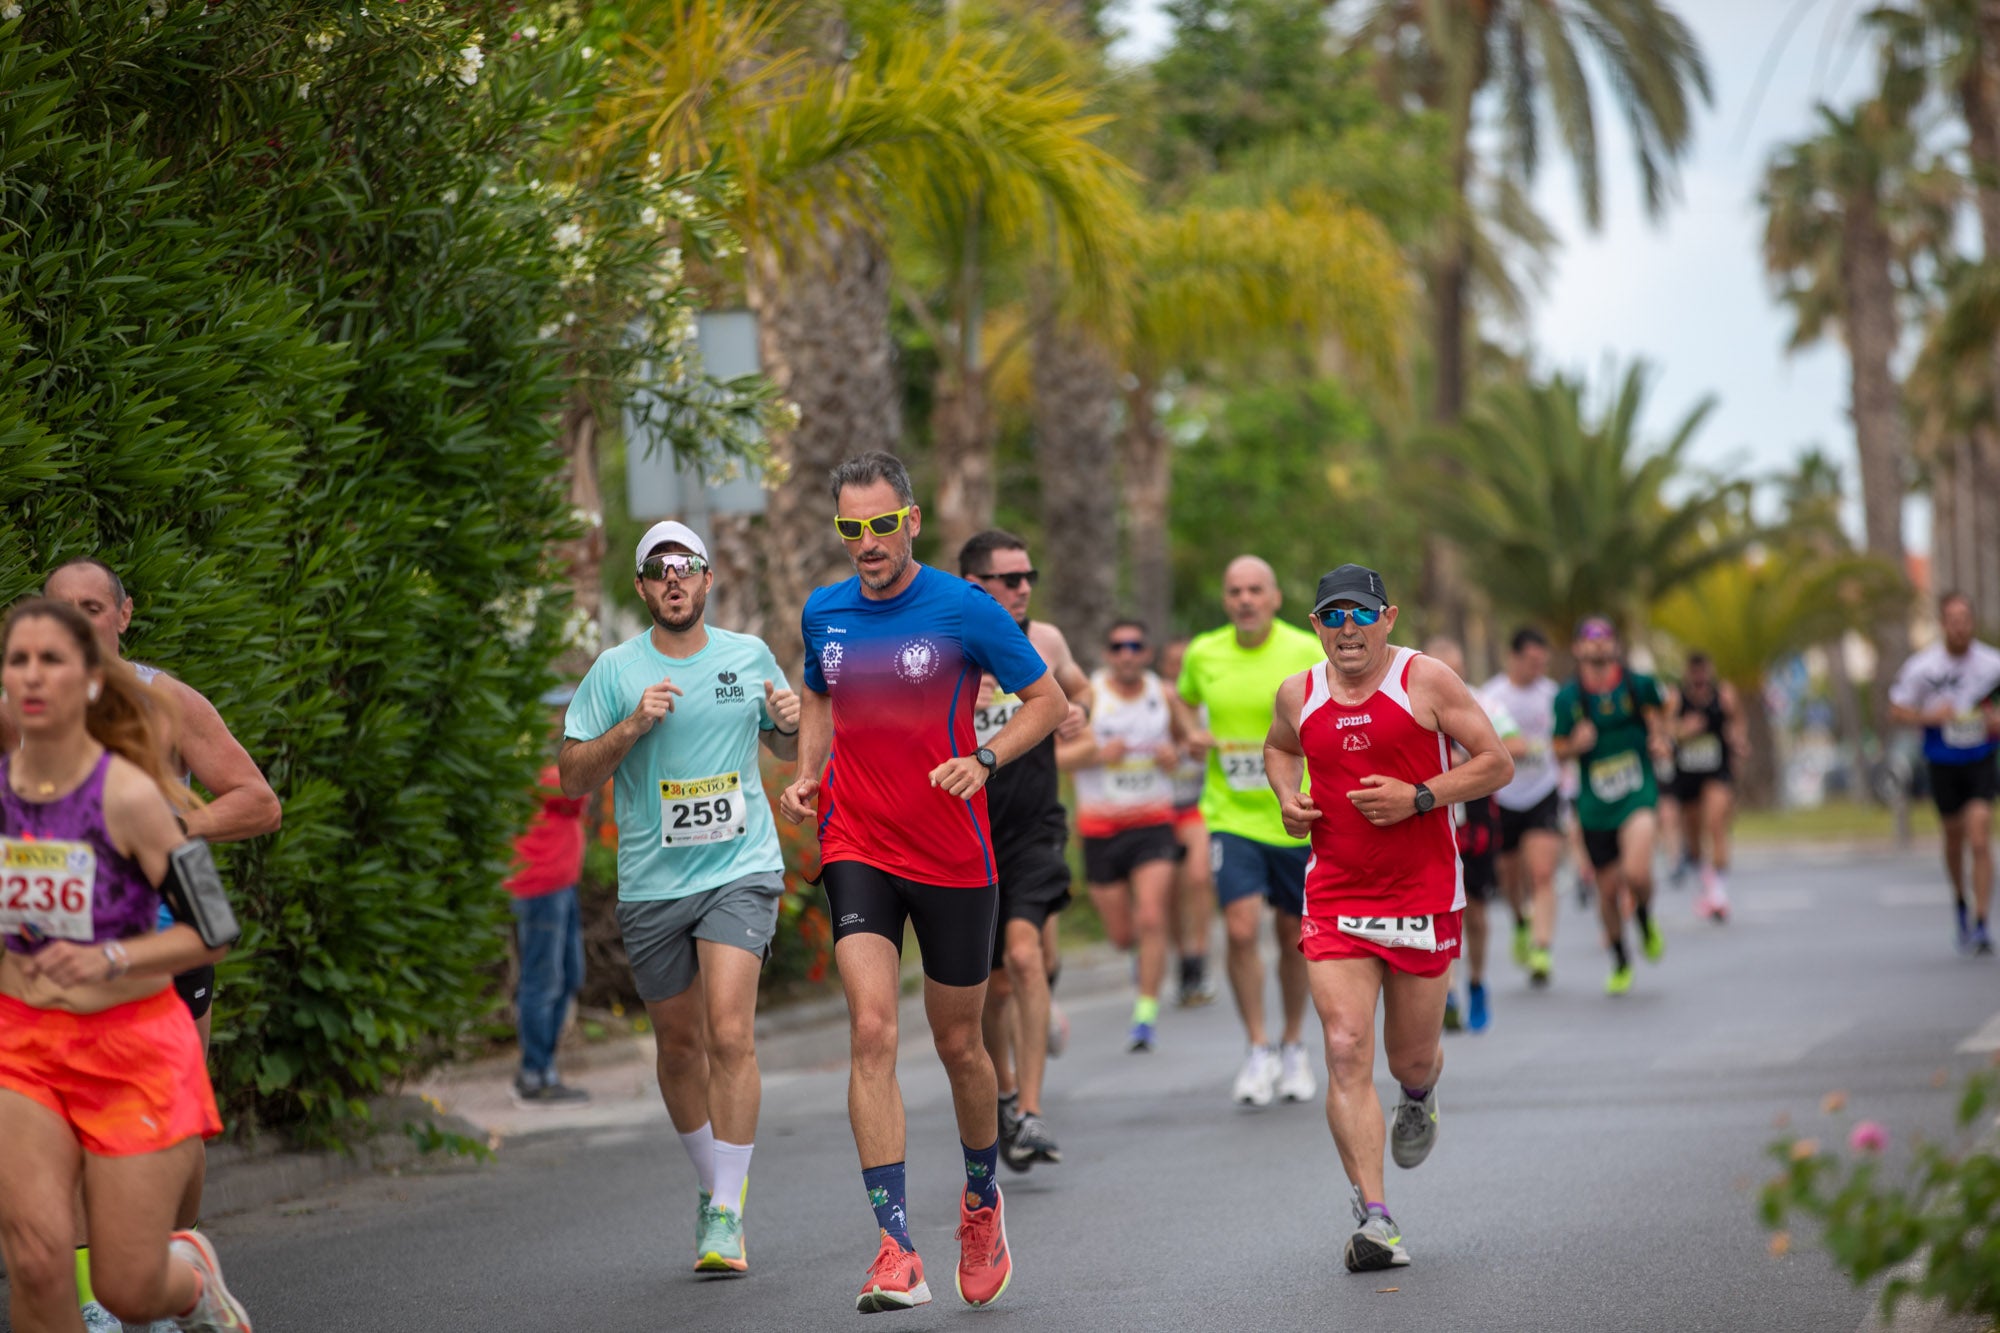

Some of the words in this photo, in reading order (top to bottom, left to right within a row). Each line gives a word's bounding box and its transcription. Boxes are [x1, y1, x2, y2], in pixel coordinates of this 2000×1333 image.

[715, 686, 744, 699] RUBI
[975, 705, 1021, 731] 34
[670, 784, 682, 796] 38
[671, 798, 732, 829] 259
[0, 875, 86, 915] 236
